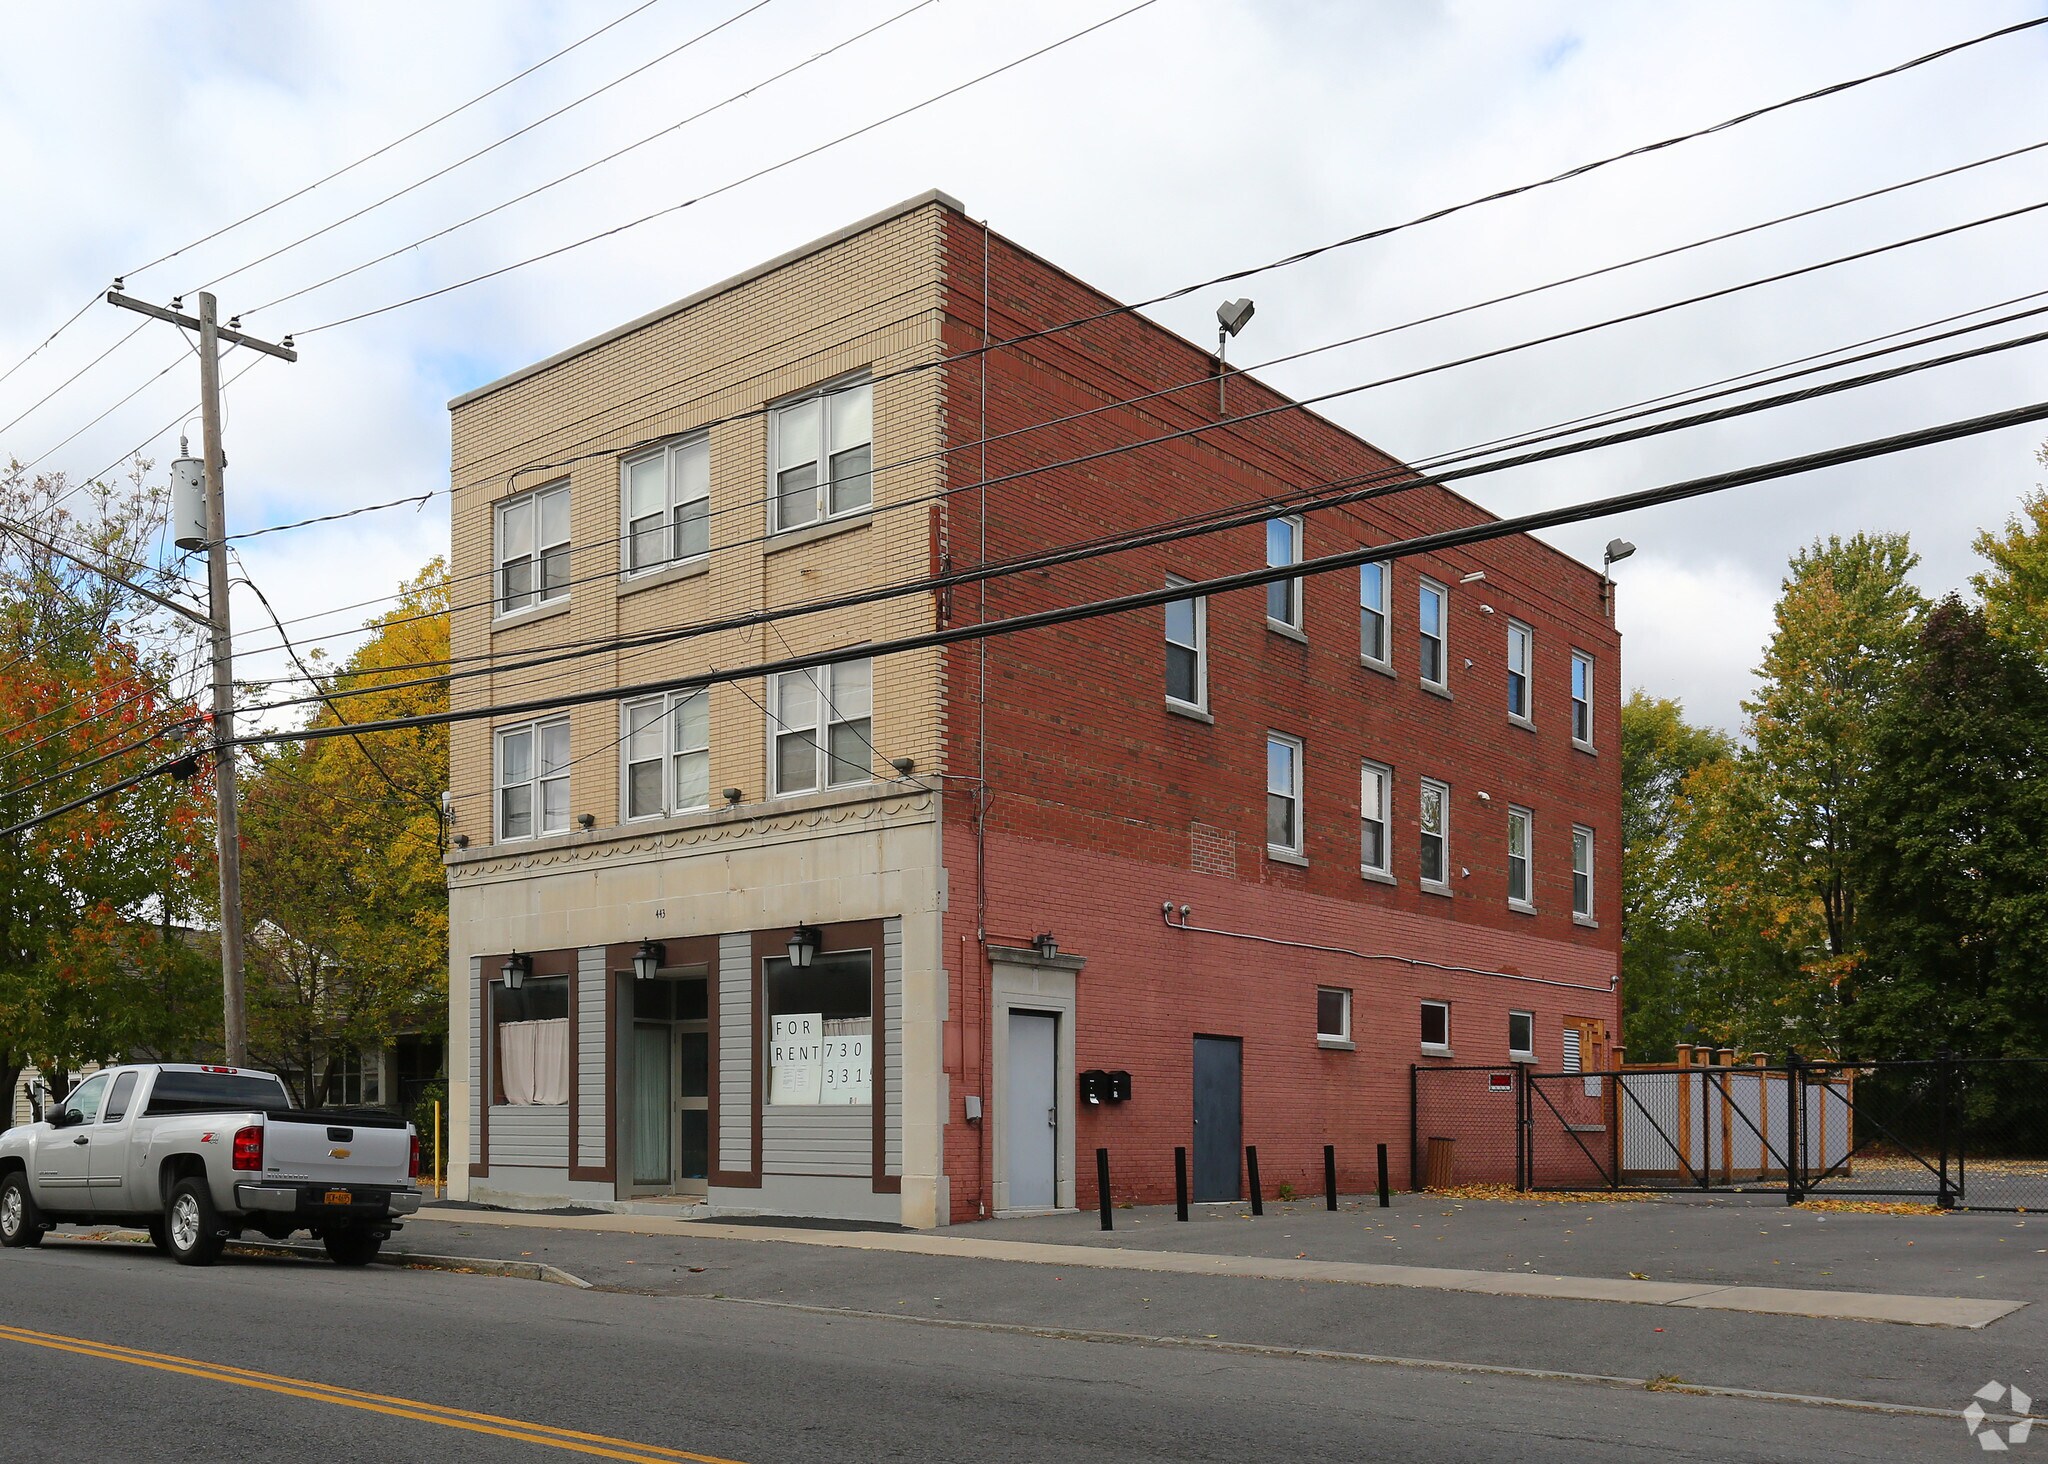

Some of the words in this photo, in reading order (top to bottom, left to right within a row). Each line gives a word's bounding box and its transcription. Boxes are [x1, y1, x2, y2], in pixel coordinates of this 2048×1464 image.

[655, 908, 666, 919] 443
[776, 1020, 811, 1036] FOR
[775, 1045, 819, 1061] RENT
[825, 1042, 862, 1058] 730
